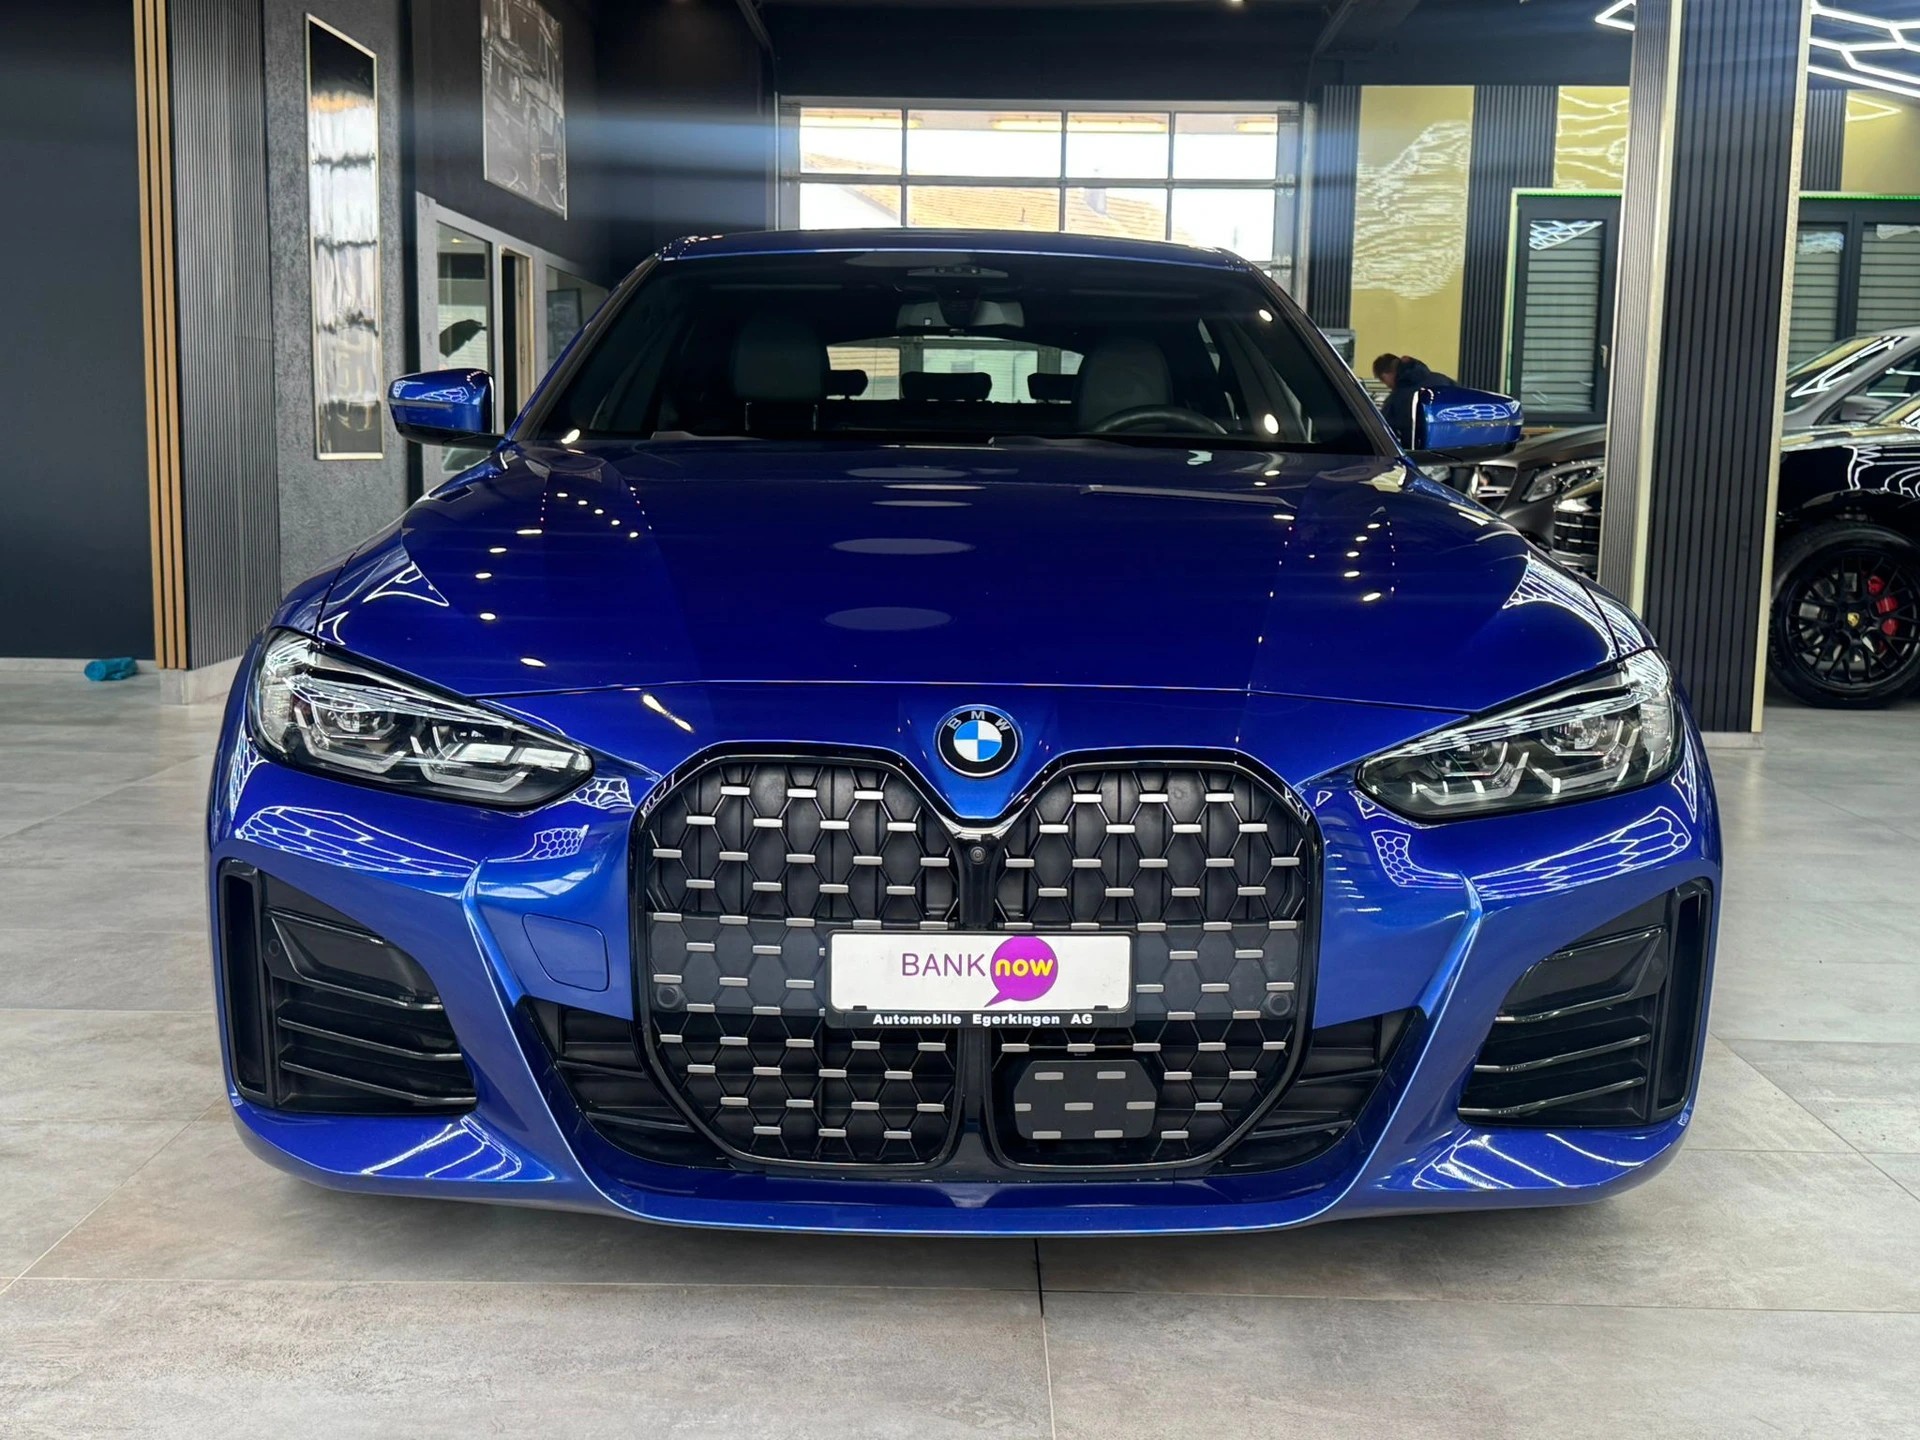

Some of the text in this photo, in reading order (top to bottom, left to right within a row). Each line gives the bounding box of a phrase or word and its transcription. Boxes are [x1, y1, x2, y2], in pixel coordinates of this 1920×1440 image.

[946, 710, 1011, 732] BMW
[901, 953, 1054, 977] BANK now
[873, 1013, 1093, 1027] Automobile Egerkingen AG
